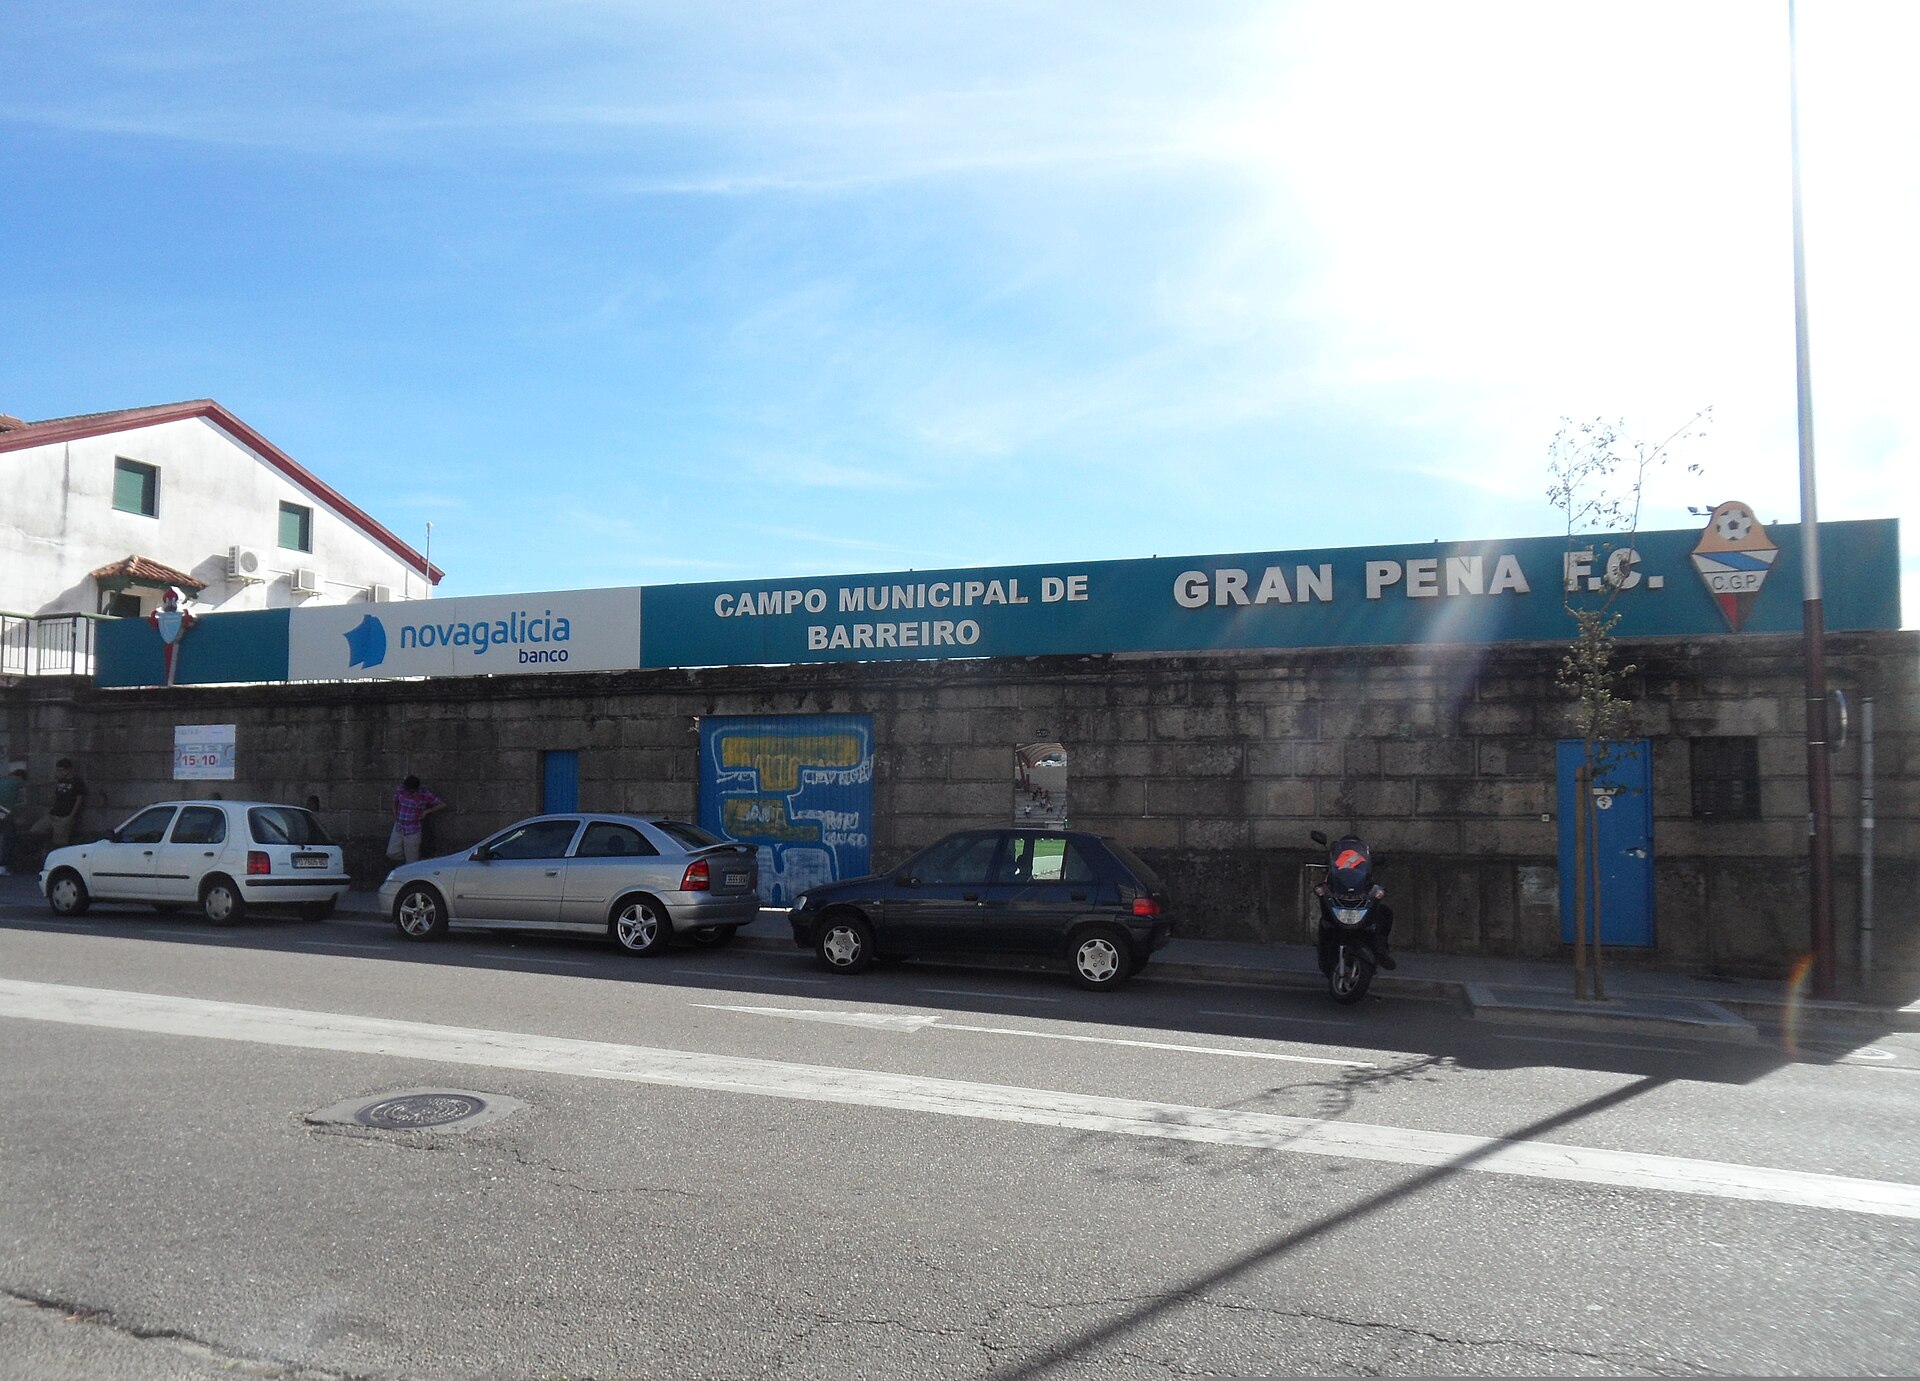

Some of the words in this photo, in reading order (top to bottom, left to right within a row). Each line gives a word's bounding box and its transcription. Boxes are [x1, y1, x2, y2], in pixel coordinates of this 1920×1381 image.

[714, 588, 828, 618] CAMPO
[838, 578, 1029, 612] MUNICIPAL
[1041, 575, 1089, 602] DE
[1173, 563, 1334, 609] GRAN
[400, 609, 571, 655] novagalicia
[807, 619, 981, 651] BARREIRO
[518, 648, 569, 664] banco
